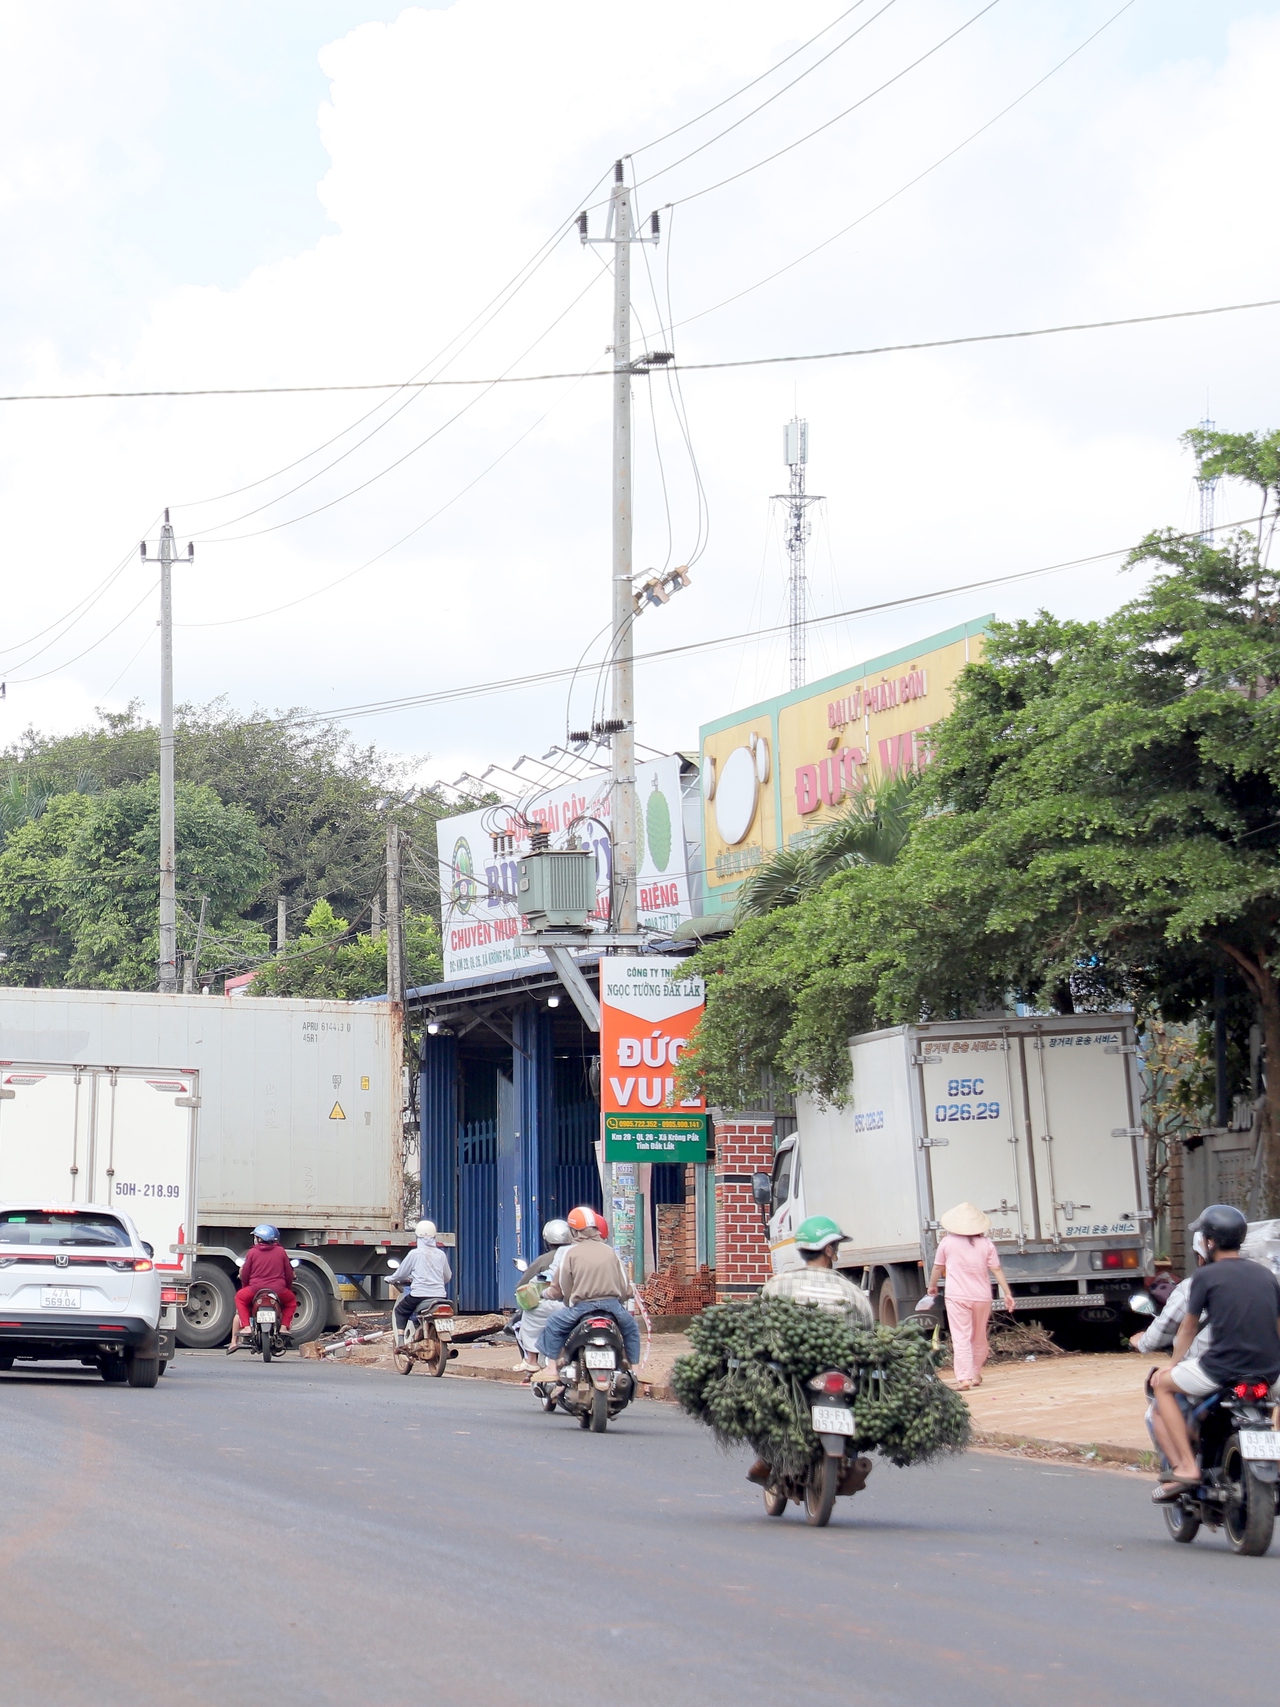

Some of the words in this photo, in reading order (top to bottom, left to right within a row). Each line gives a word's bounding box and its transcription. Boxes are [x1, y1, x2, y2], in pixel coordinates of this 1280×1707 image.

[795, 737, 868, 815] ĐỨC
[451, 919, 492, 951] CHUYÊN
[640, 882, 679, 912] RIÊNG
[626, 966, 648, 978] CÔNG
[650, 968, 659, 978] TY
[607, 984, 630, 999] NGỌC
[633, 982, 661, 997] TƯỜNG
[302, 1022, 318, 1032] APRU
[302, 1034, 318, 1042] 45R1
[1048, 1036, 1072, 1048] 장거리
[1075, 1036, 1090, 1046] 운송
[1092, 1034, 1119, 1044] 서비스
[617, 1030, 688, 1068] ĐỨC
[924, 1042, 950, 1055] 장거리
[951, 1041, 970, 1054] 운송
[970, 1040, 998, 1052] 서비스
[948, 1078, 985, 1097] 85C
[935, 1102, 1000, 1122] 026.29
[636, 1133, 644, 1141] QL
[658, 1133, 667, 1141] Xã
[668, 1133, 686, 1142] Krông
[1066, 1226, 1090, 1236] 장거리
[1092, 1225, 1108, 1234] 운송
[1110, 1223, 1135, 1233] 서비스
[52, 1289, 70, 1298] 47A
[45, 1298, 76, 1307] 569.04
[1087, 1309, 1110, 1320] KIA
[818, 1409, 846, 1420] 93-F1
